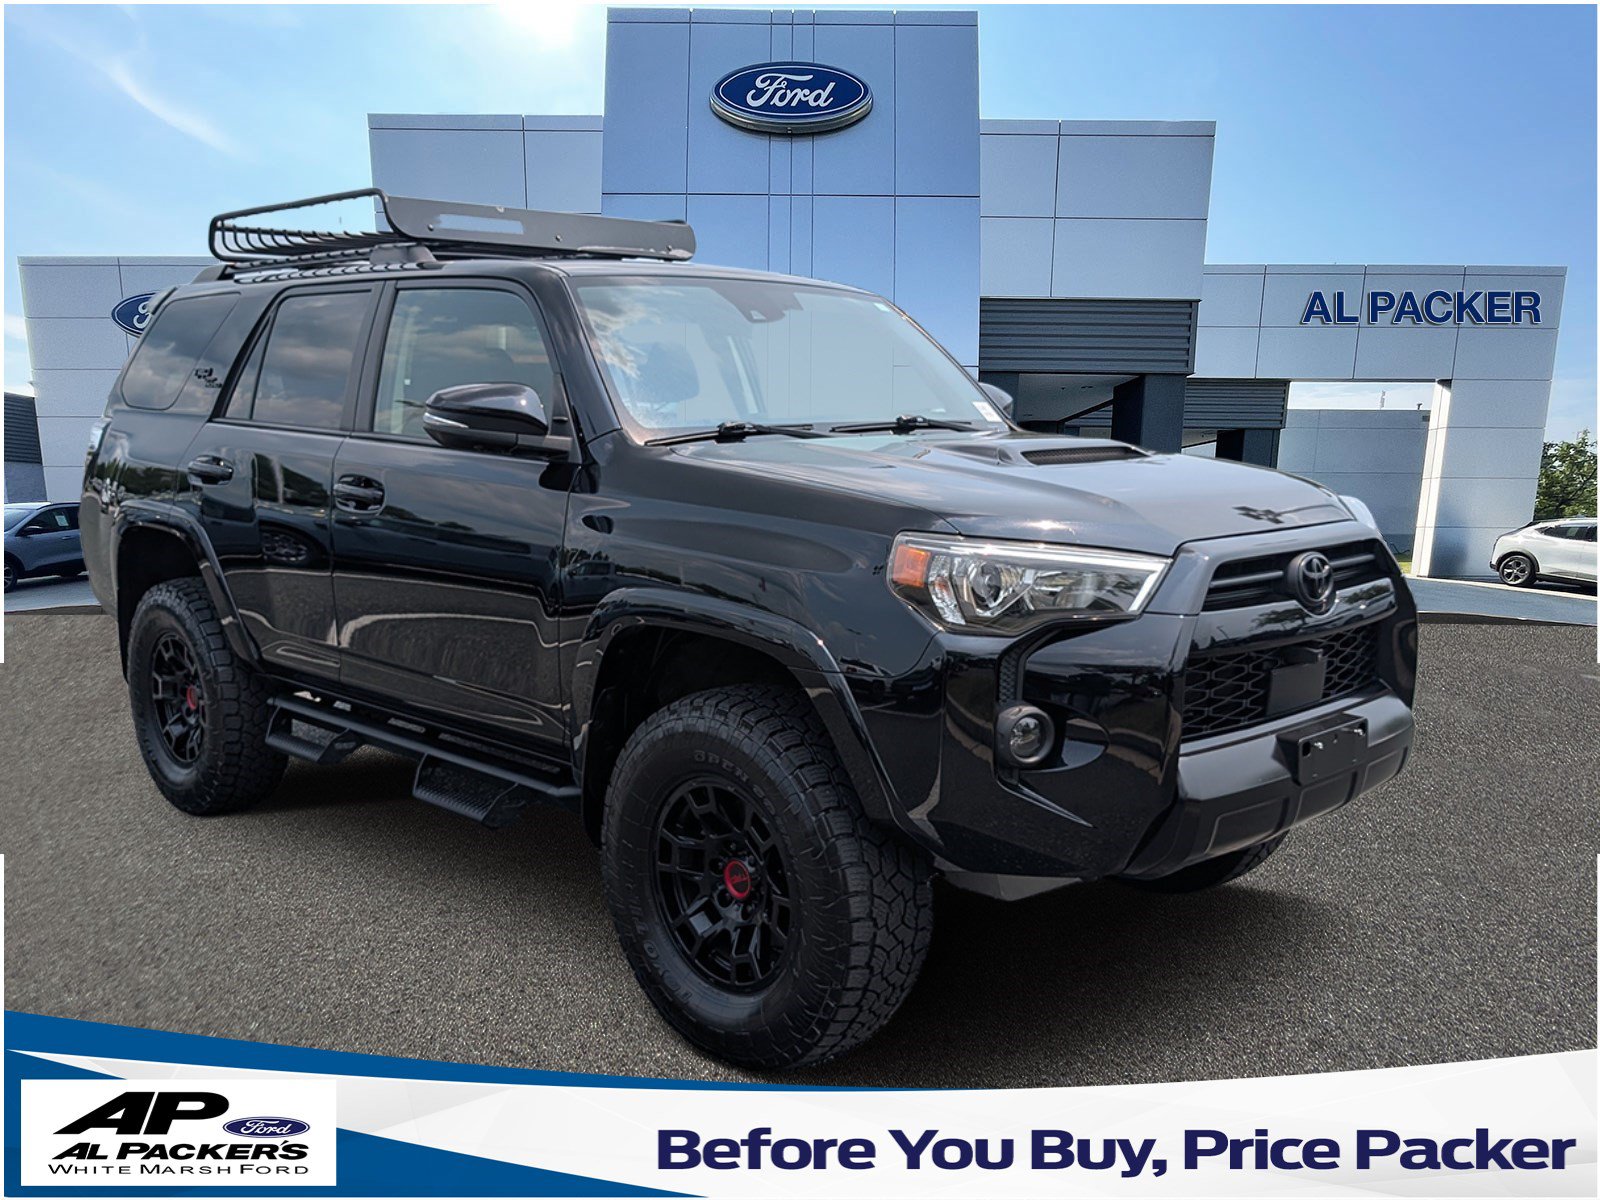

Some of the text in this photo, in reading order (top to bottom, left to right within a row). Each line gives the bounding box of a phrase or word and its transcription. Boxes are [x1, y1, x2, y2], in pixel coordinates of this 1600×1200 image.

[746, 73, 836, 107] Ford
[1302, 290, 1542, 324] AL PACKER
